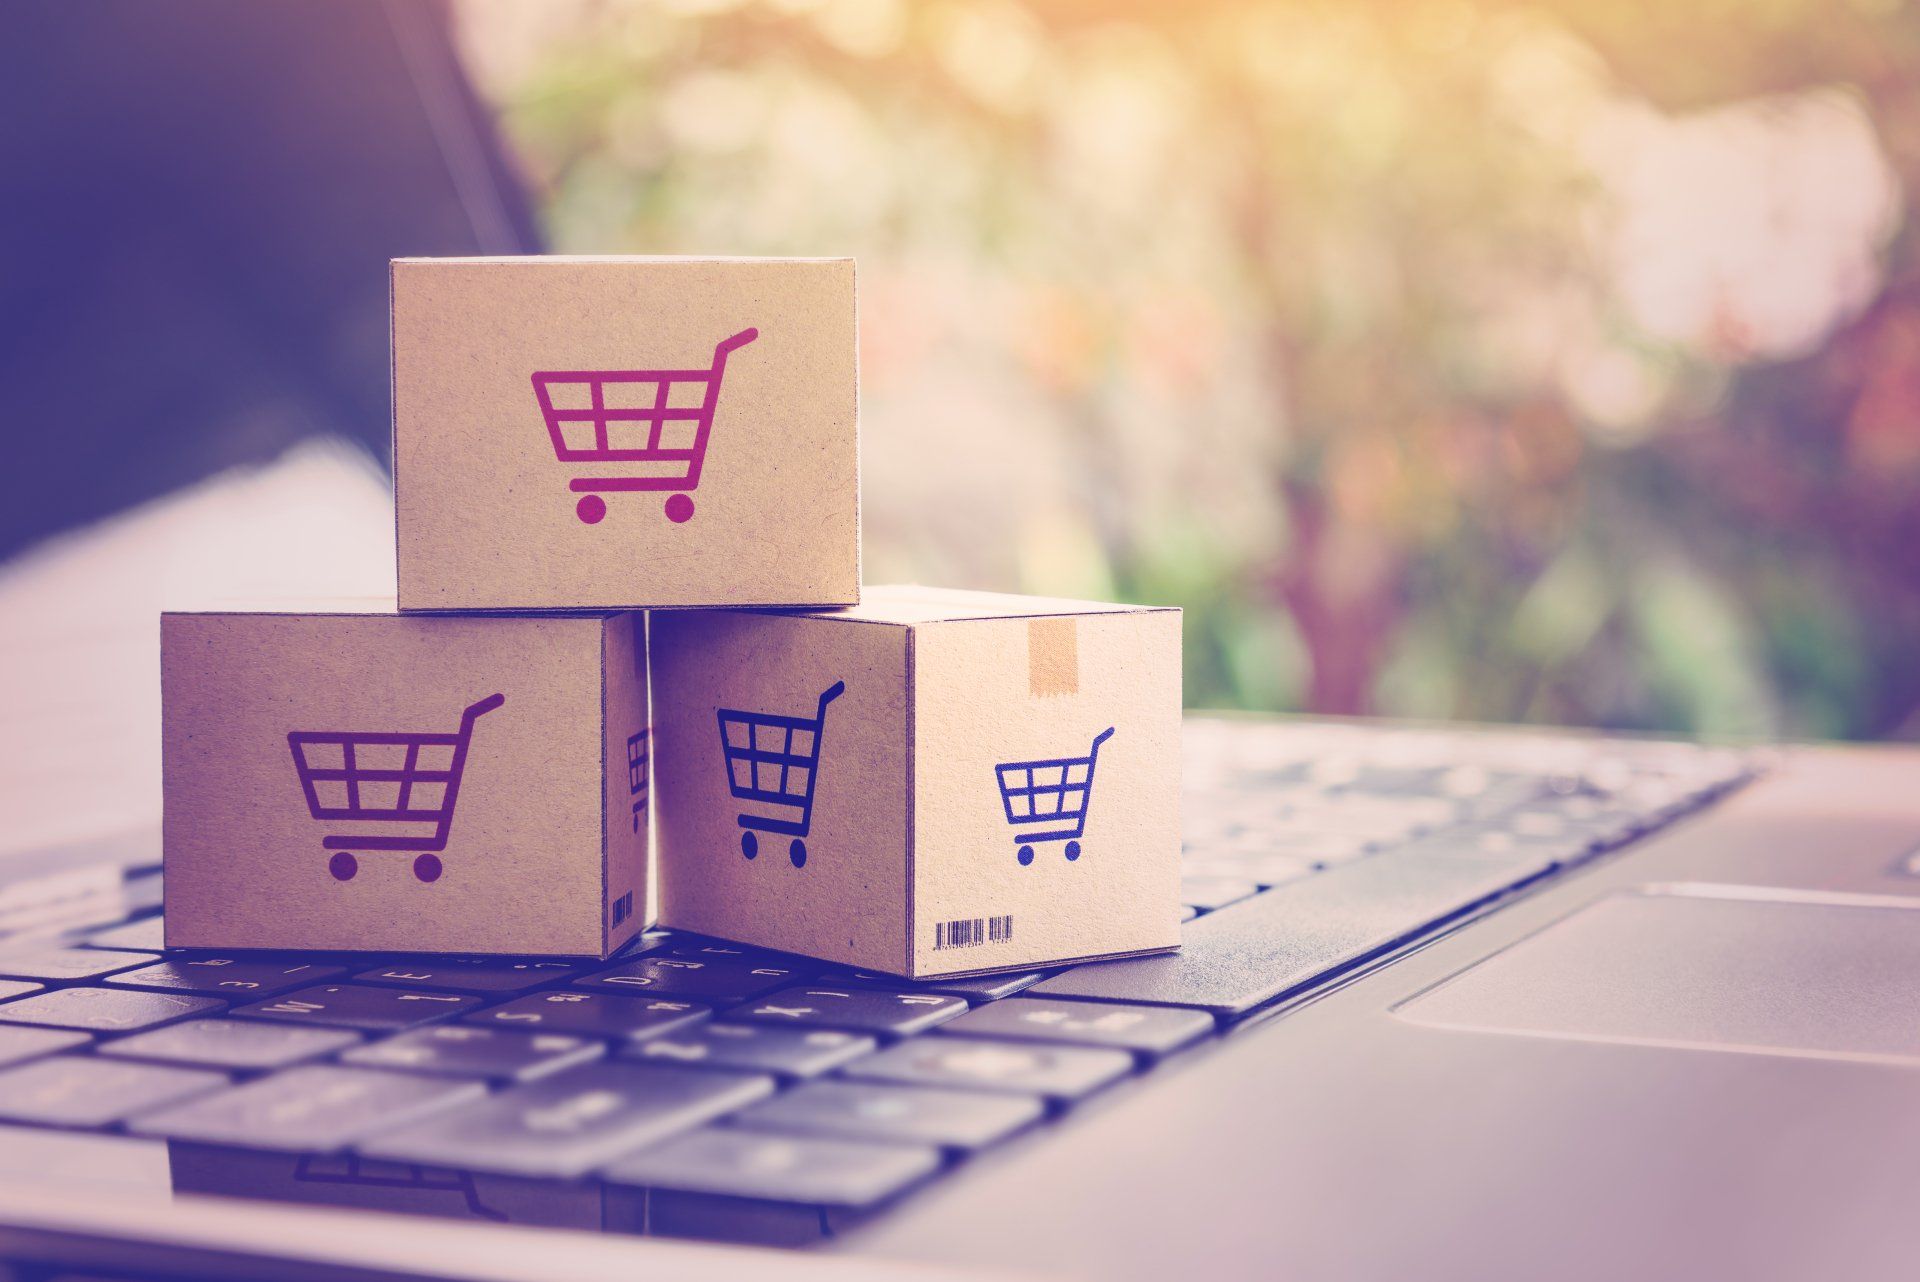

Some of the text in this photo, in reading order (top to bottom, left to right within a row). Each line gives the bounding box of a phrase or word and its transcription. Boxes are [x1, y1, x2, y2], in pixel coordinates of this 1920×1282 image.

[381, 970, 432, 980] E
[218, 980, 261, 989] 3
[602, 976, 652, 985] D
[260, 1001, 326, 1013] W
[753, 1005, 813, 1018] X
[495, 1012, 541, 1022] S
